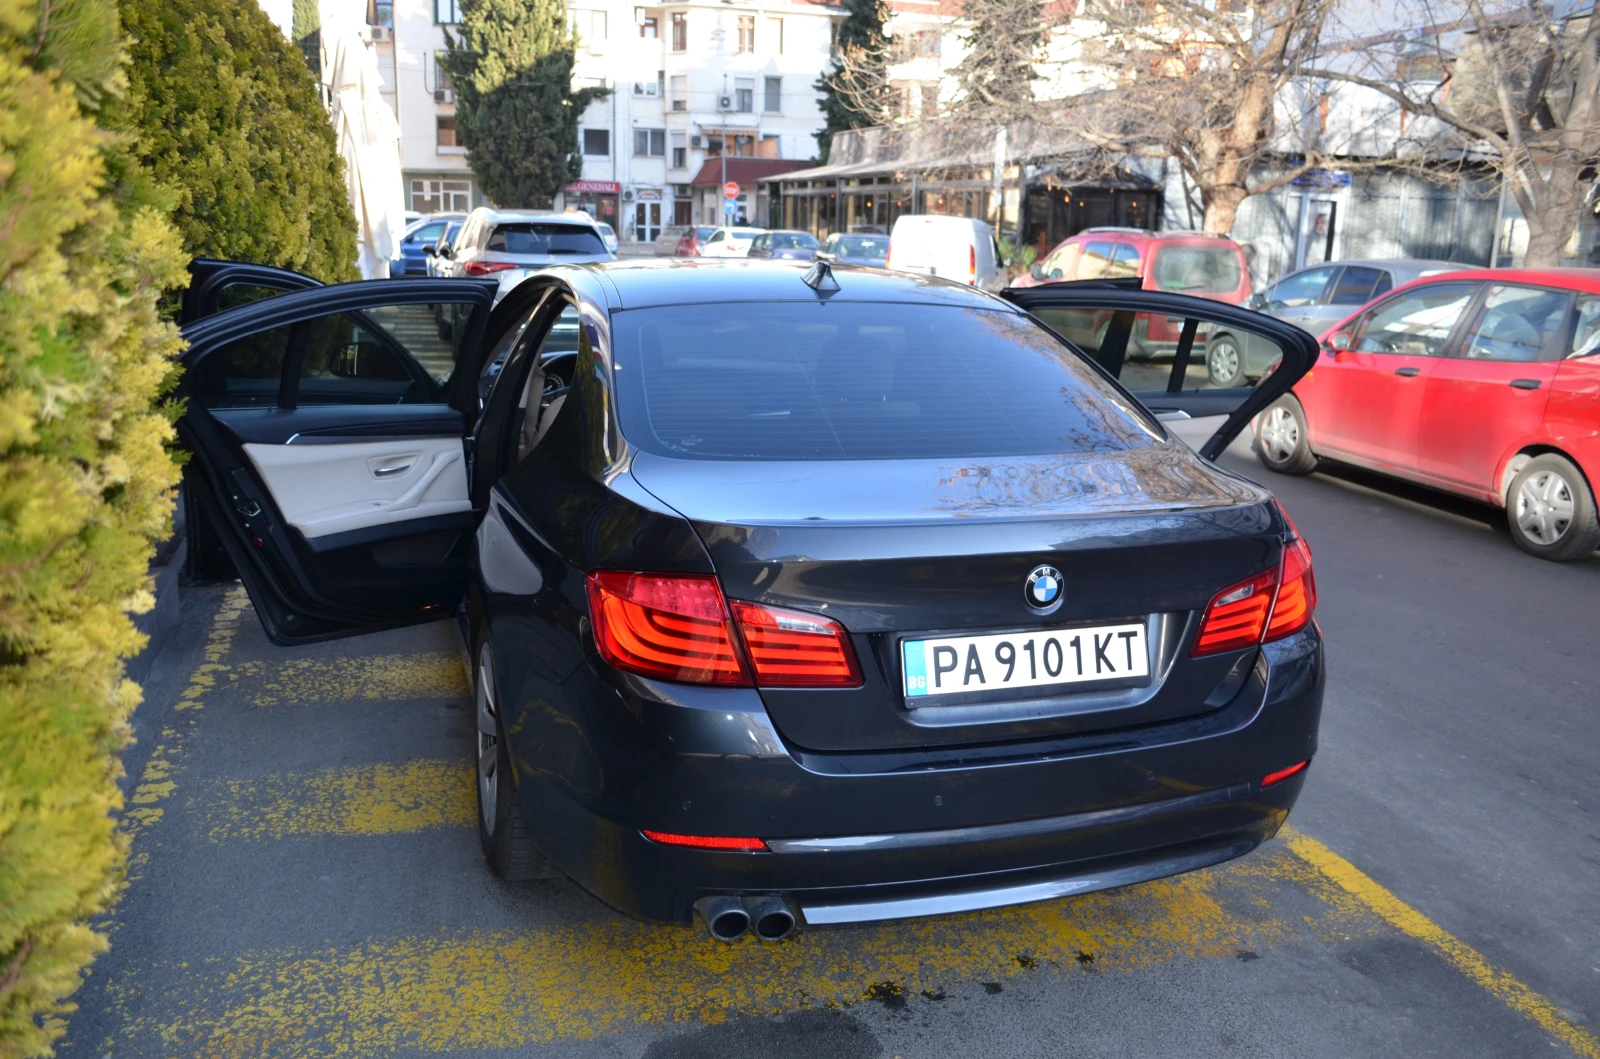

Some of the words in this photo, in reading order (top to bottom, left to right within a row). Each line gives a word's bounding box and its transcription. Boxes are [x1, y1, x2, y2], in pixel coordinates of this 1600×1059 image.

[577, 182, 616, 191] GENERALI
[1029, 567, 1062, 583] BMW
[908, 675, 926, 689] BG
